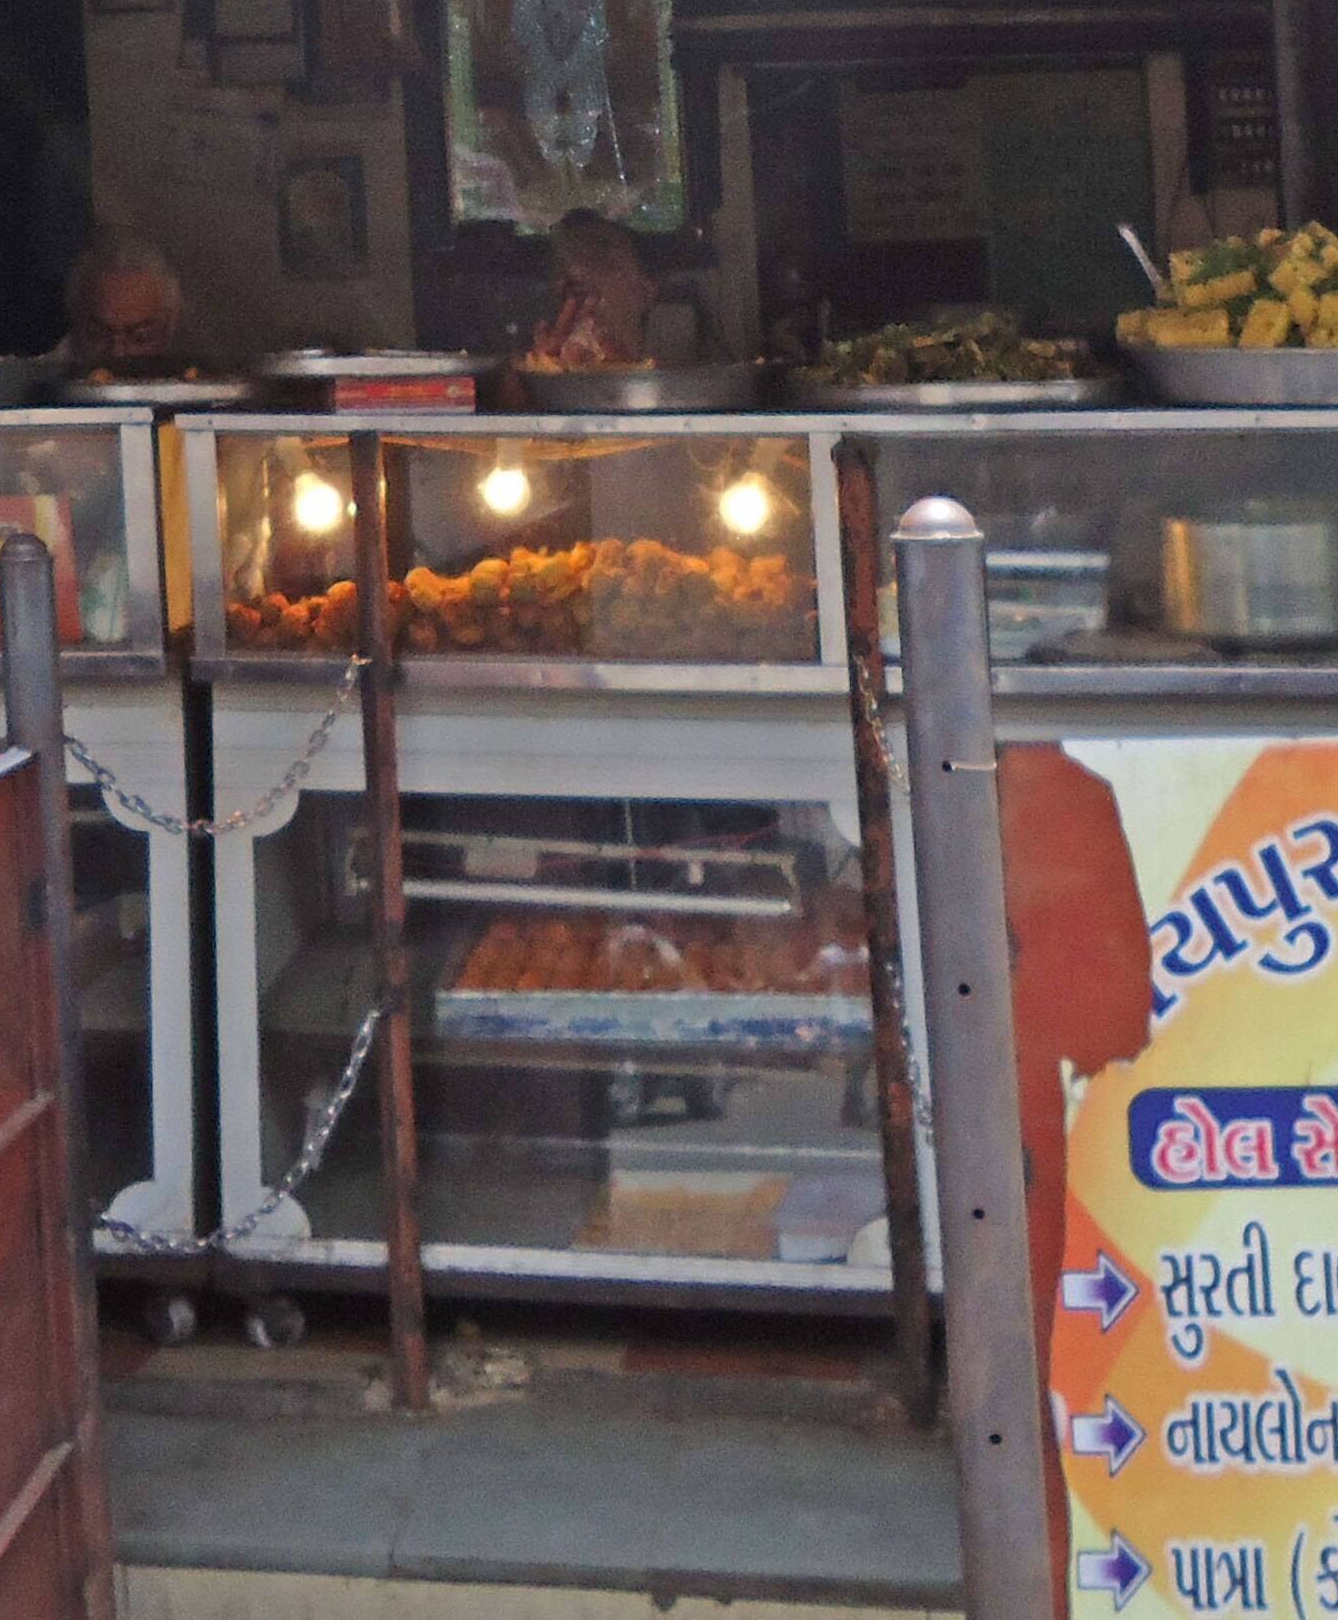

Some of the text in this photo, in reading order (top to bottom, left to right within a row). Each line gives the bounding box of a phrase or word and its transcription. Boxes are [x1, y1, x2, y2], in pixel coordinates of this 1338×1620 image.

[1152, 1097, 1276, 1182] હોલ
[1162, 1221, 1276, 1358] સુરતી
[1172, 1546, 1267, 1611] પાત્રા
